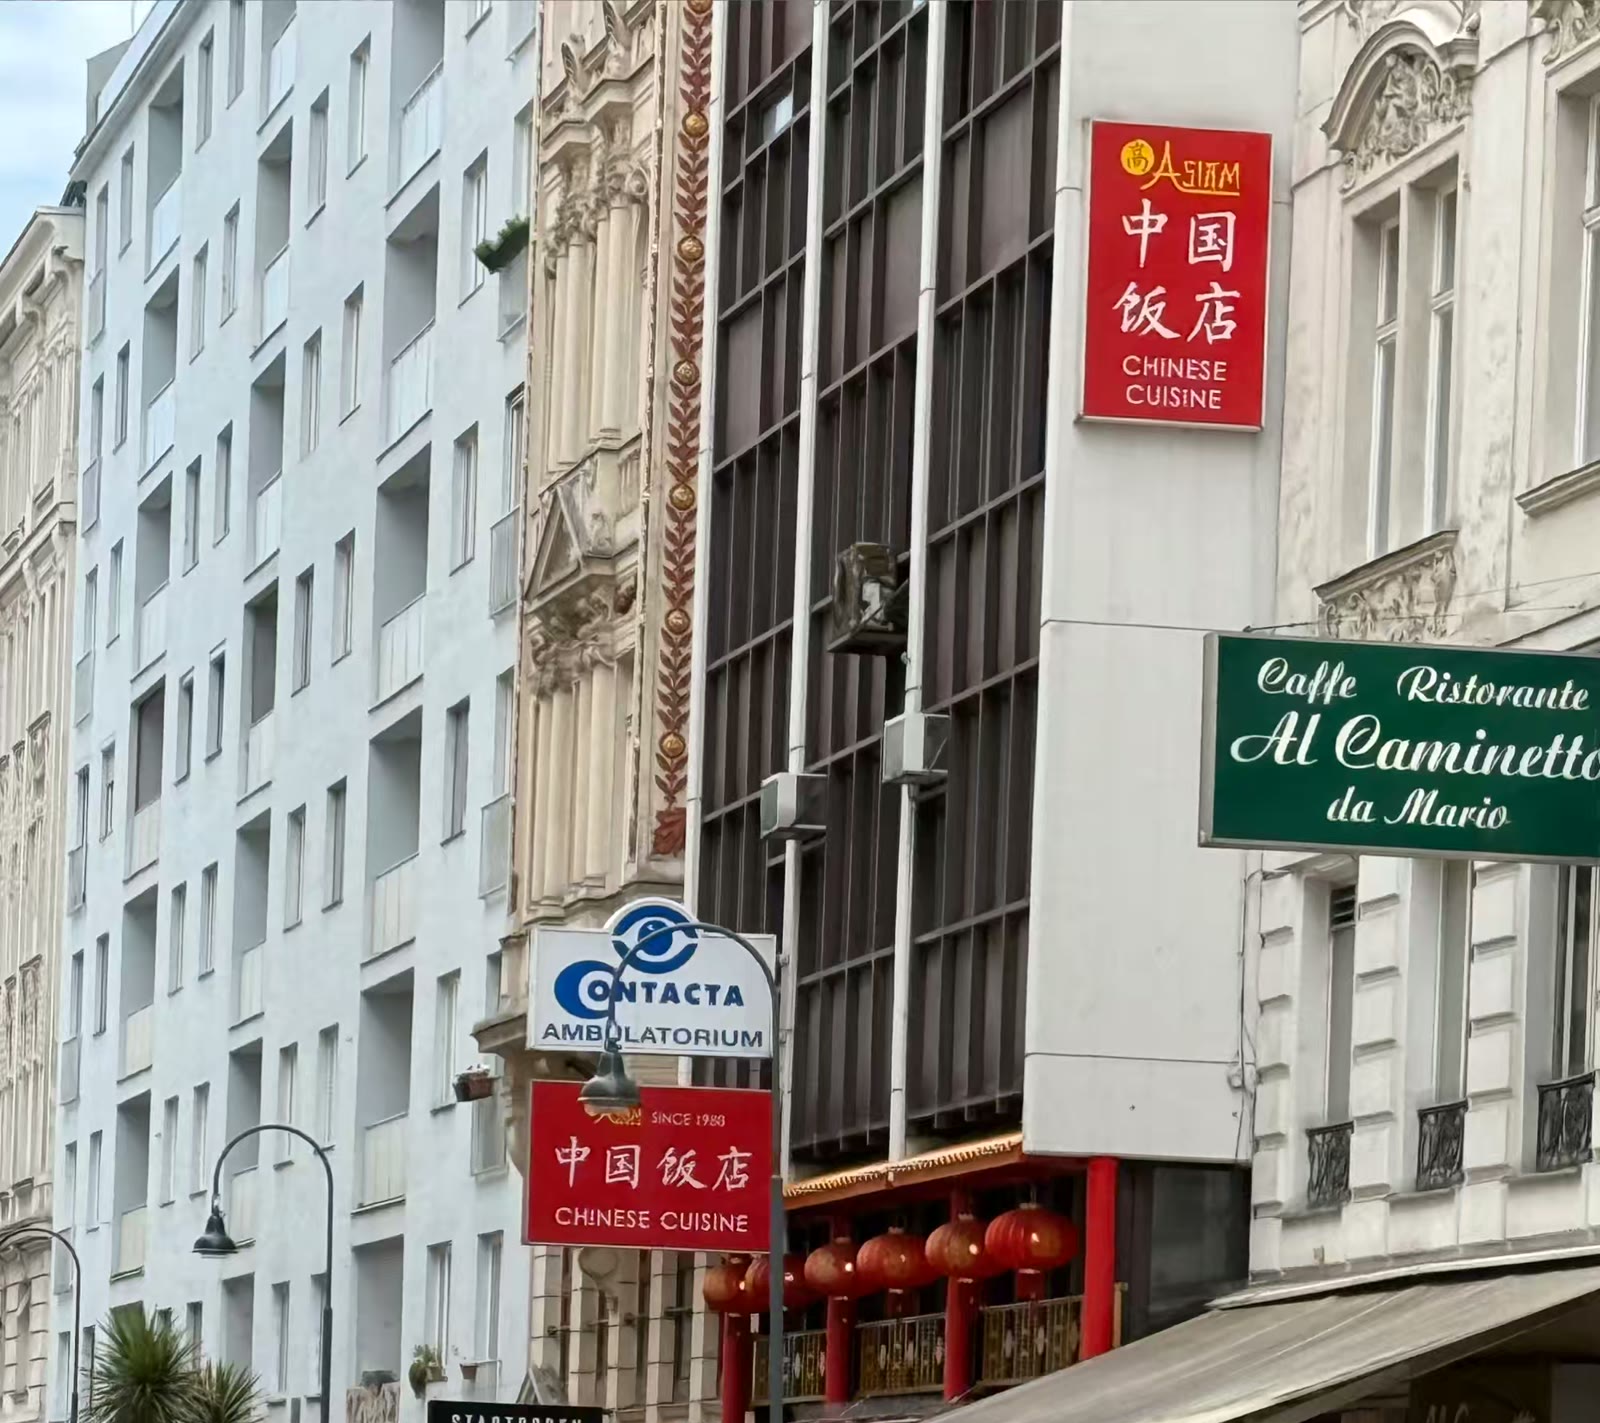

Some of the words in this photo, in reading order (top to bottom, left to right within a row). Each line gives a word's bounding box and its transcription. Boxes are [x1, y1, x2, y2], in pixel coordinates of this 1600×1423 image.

[1121, 198, 1237, 273] 中国
[1112, 281, 1241, 345] 饭店
[1122, 354, 1227, 381] CHINESE
[1125, 384, 1222, 409] CUISINE
[1257, 657, 1358, 705] Caffe
[1396, 665, 1590, 711] Ristorante
[1230, 710, 1322, 766] Al
[1334, 714, 1600, 780] Caminetto
[1326, 785, 1377, 822] da
[1384, 787, 1511, 830] Mario
[554, 960, 745, 1020] CONTACTA
[651, 1111, 692, 1126] SINCE
[554, 1135, 753, 1192] 中国饭店
[554, 1206, 650, 1229] CHINESE
[660, 1211, 749, 1233] CUISINE
